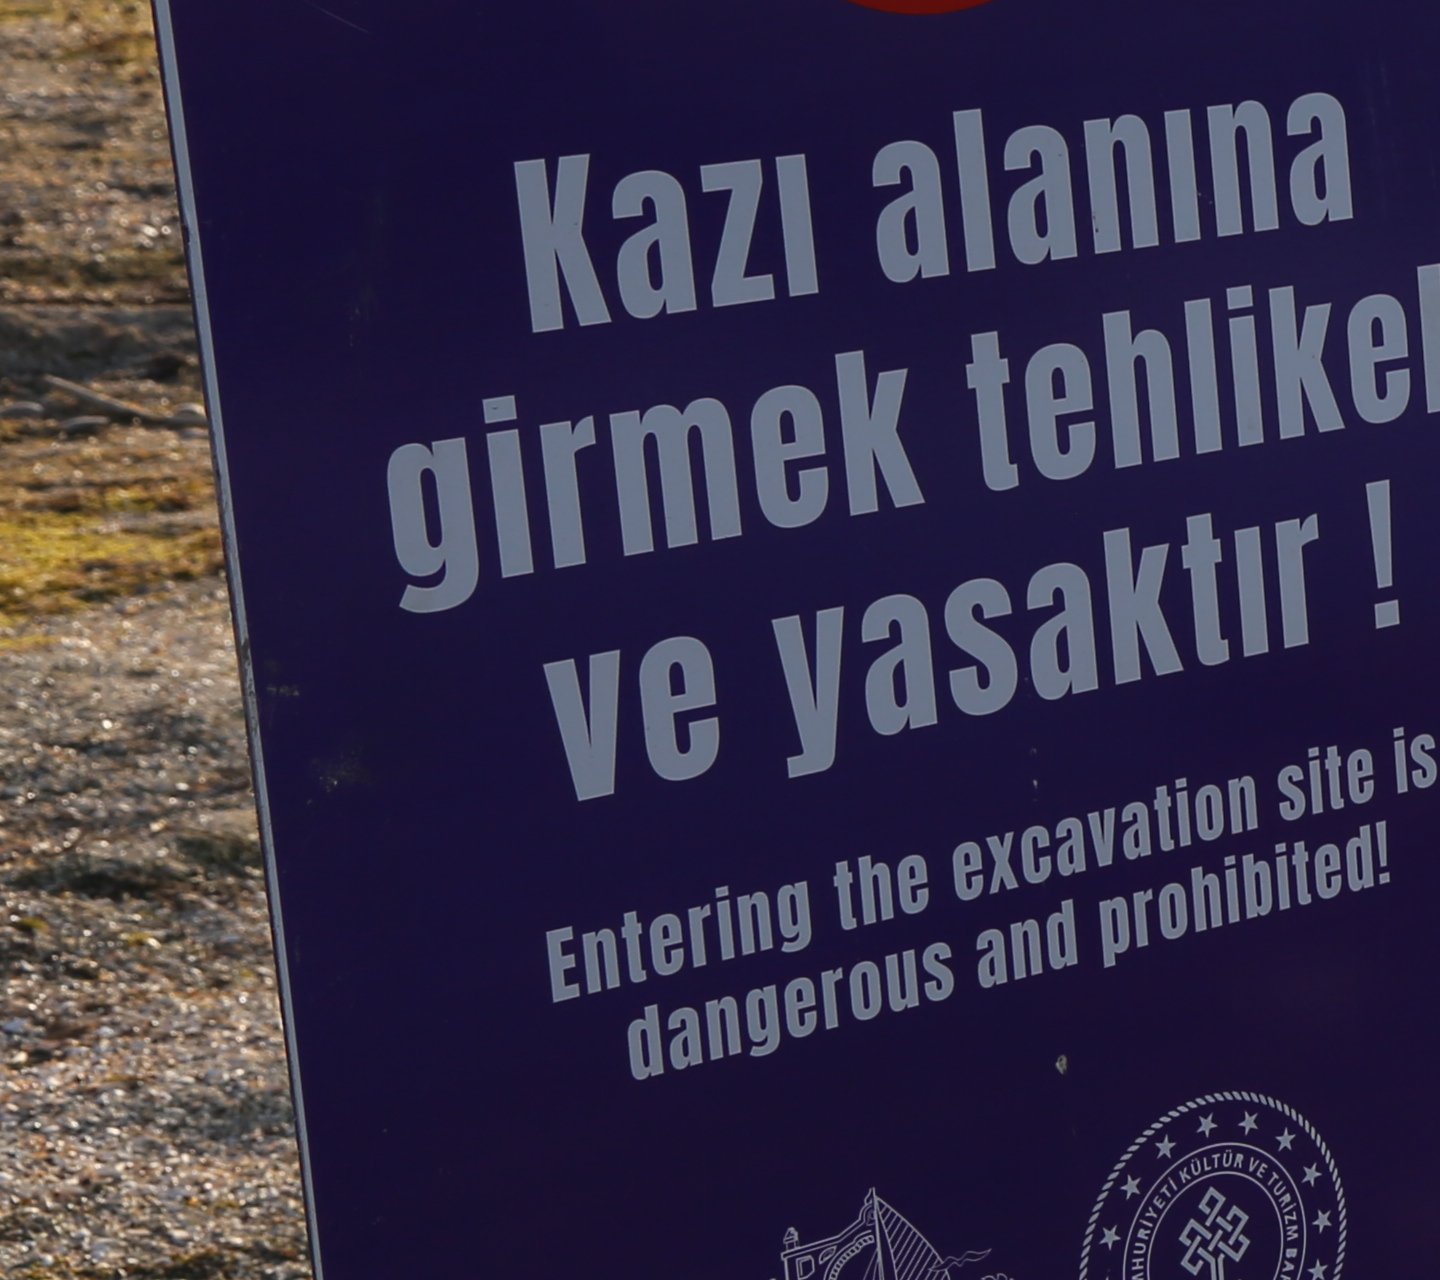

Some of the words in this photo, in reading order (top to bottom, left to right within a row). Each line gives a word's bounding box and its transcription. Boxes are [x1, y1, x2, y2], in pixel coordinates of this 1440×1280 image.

[514, 154, 819, 333] Kazı
[872, 92, 1353, 283] alanına
[387, 350, 925, 613] girmek
[543, 636, 719, 801] ve
[772, 513, 1319, 778] yasaktır
[1366, 479, 1400, 629] !
[546, 881, 811, 1002] Entering
[833, 855, 929, 952] the
[953, 776, 1258, 900] excavation
[1278, 746, 1374, 820] site
[1393, 727, 1437, 793] is
[627, 942, 954, 1080] dangerous
[977, 899, 1078, 988] and
[1099, 820, 1391, 968] prohibited!
[1179, 1149, 1244, 1183] KÜLTÜR
[1249, 1157, 1268, 1178] VE
[1267, 1172, 1298, 1241] TURİZM
